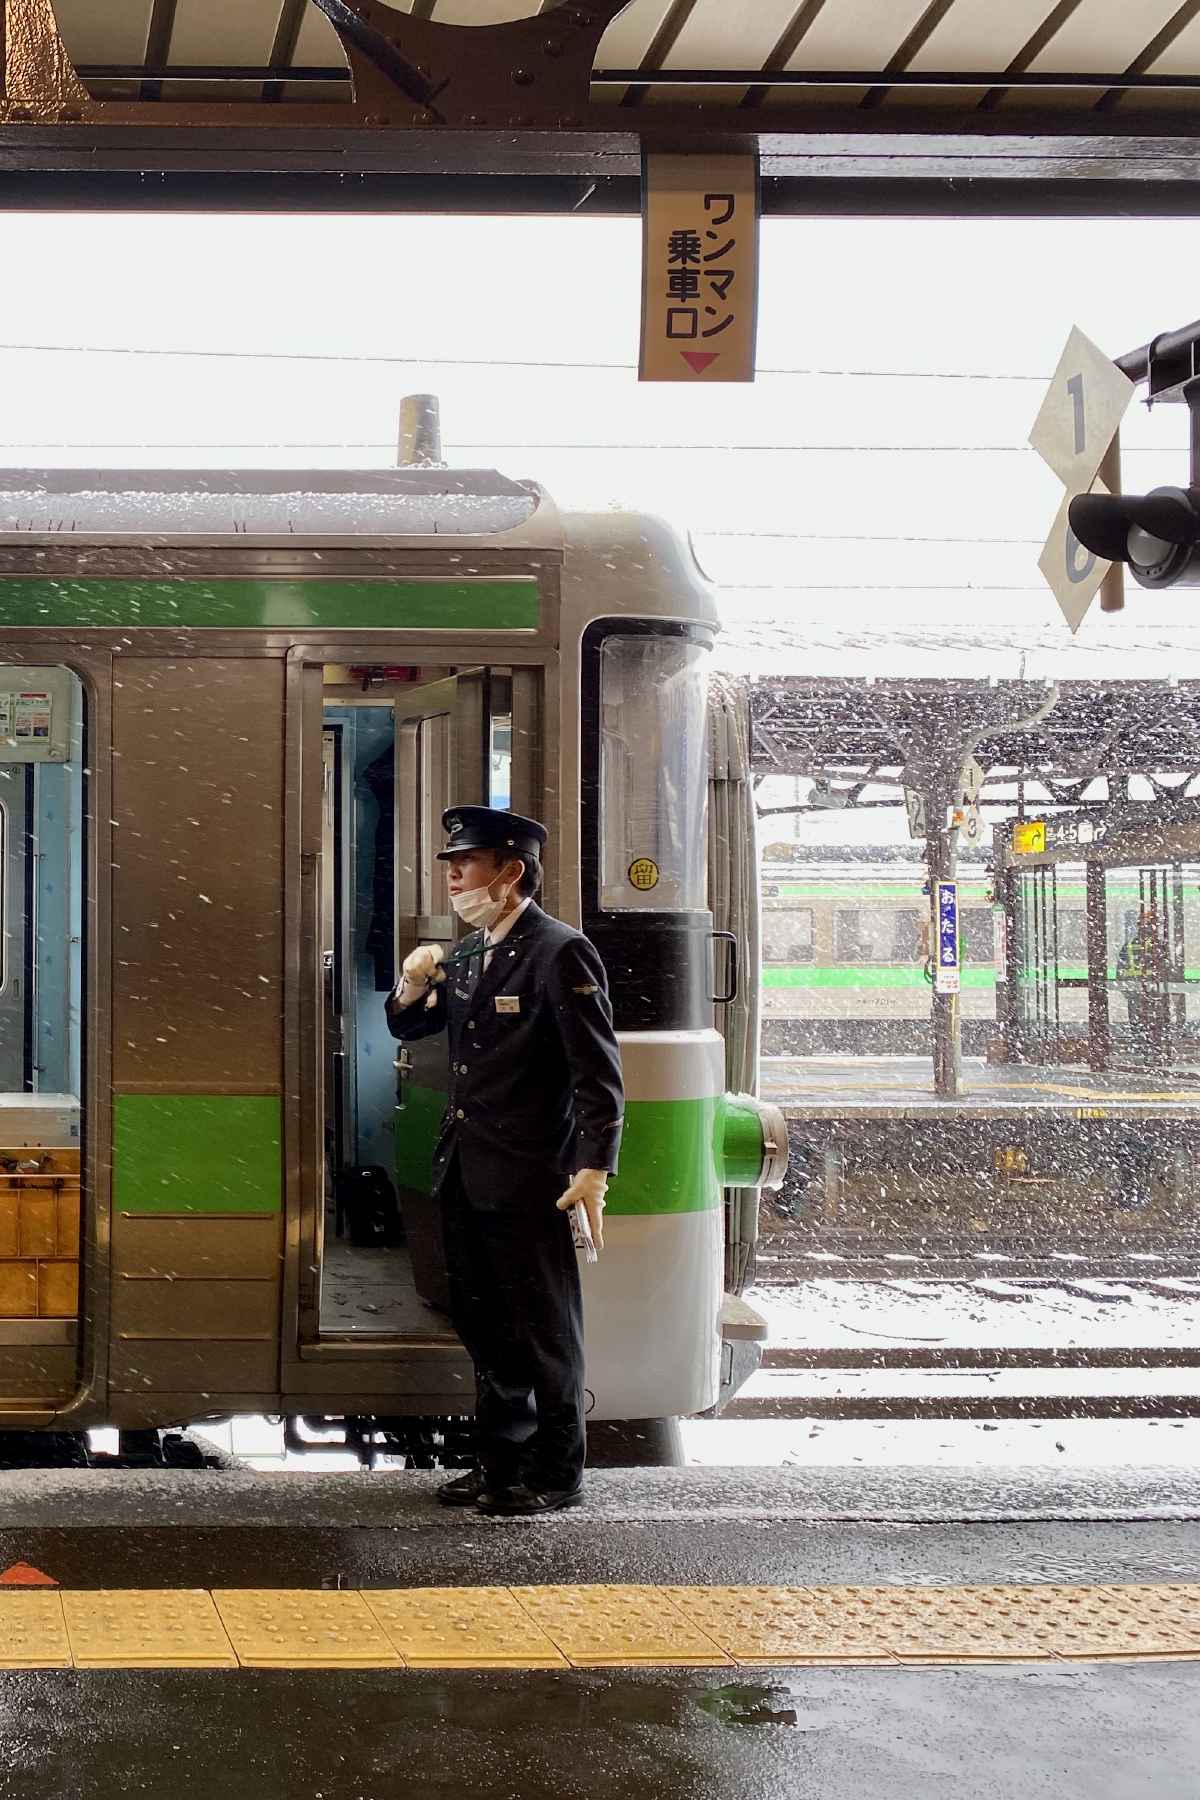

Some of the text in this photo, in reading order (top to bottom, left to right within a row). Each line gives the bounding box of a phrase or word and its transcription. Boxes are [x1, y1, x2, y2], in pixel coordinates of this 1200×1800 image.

[667, 230, 702, 338] 乗車口
[703, 194, 736, 338] ワンマン
[1067, 373, 1085, 455] 1
[967, 818, 977, 839] 3
[940, 889, 955, 963] おたる
